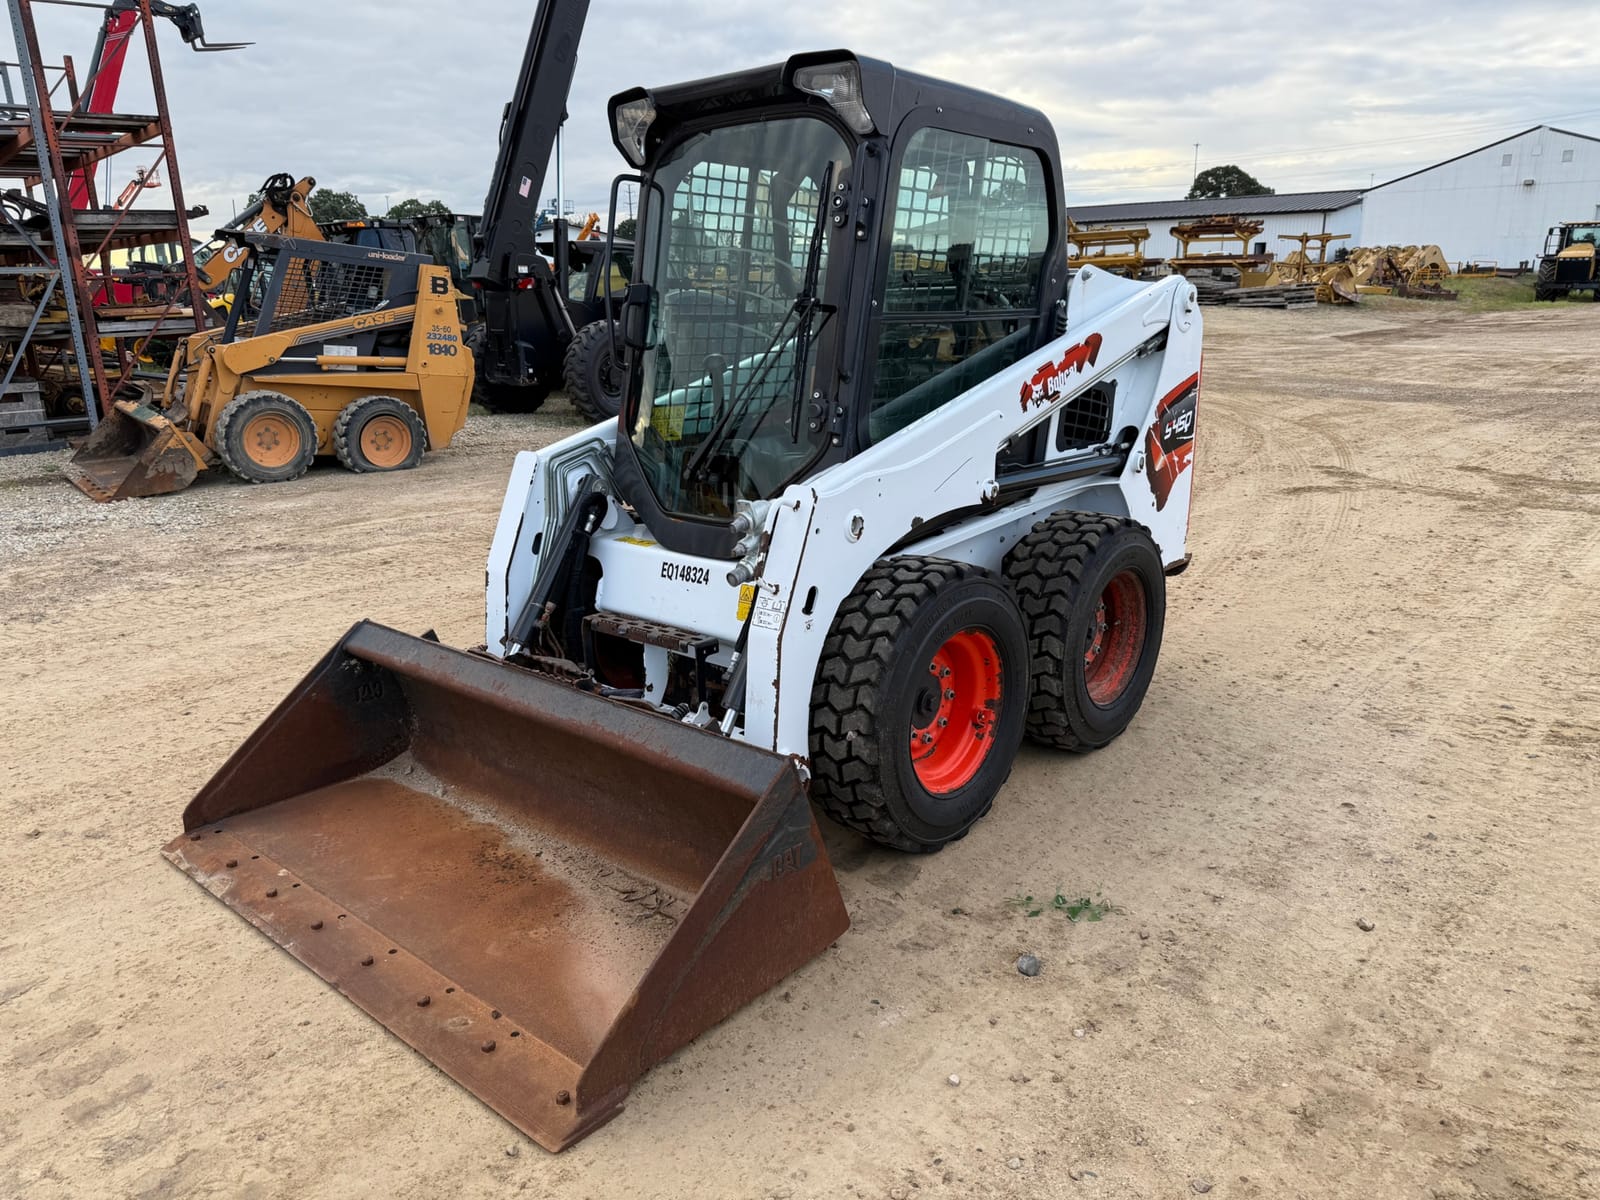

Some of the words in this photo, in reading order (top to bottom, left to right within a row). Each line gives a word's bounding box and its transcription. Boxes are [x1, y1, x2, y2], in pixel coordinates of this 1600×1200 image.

[224, 217, 268, 263] CE
[367, 251, 406, 261] uni-loader
[431, 276, 449, 295] B
[352, 311, 395, 329] CASE
[427, 343, 457, 357] 1840
[1047, 362, 1078, 396] Bobcat
[661, 561, 710, 585] EQ148324
